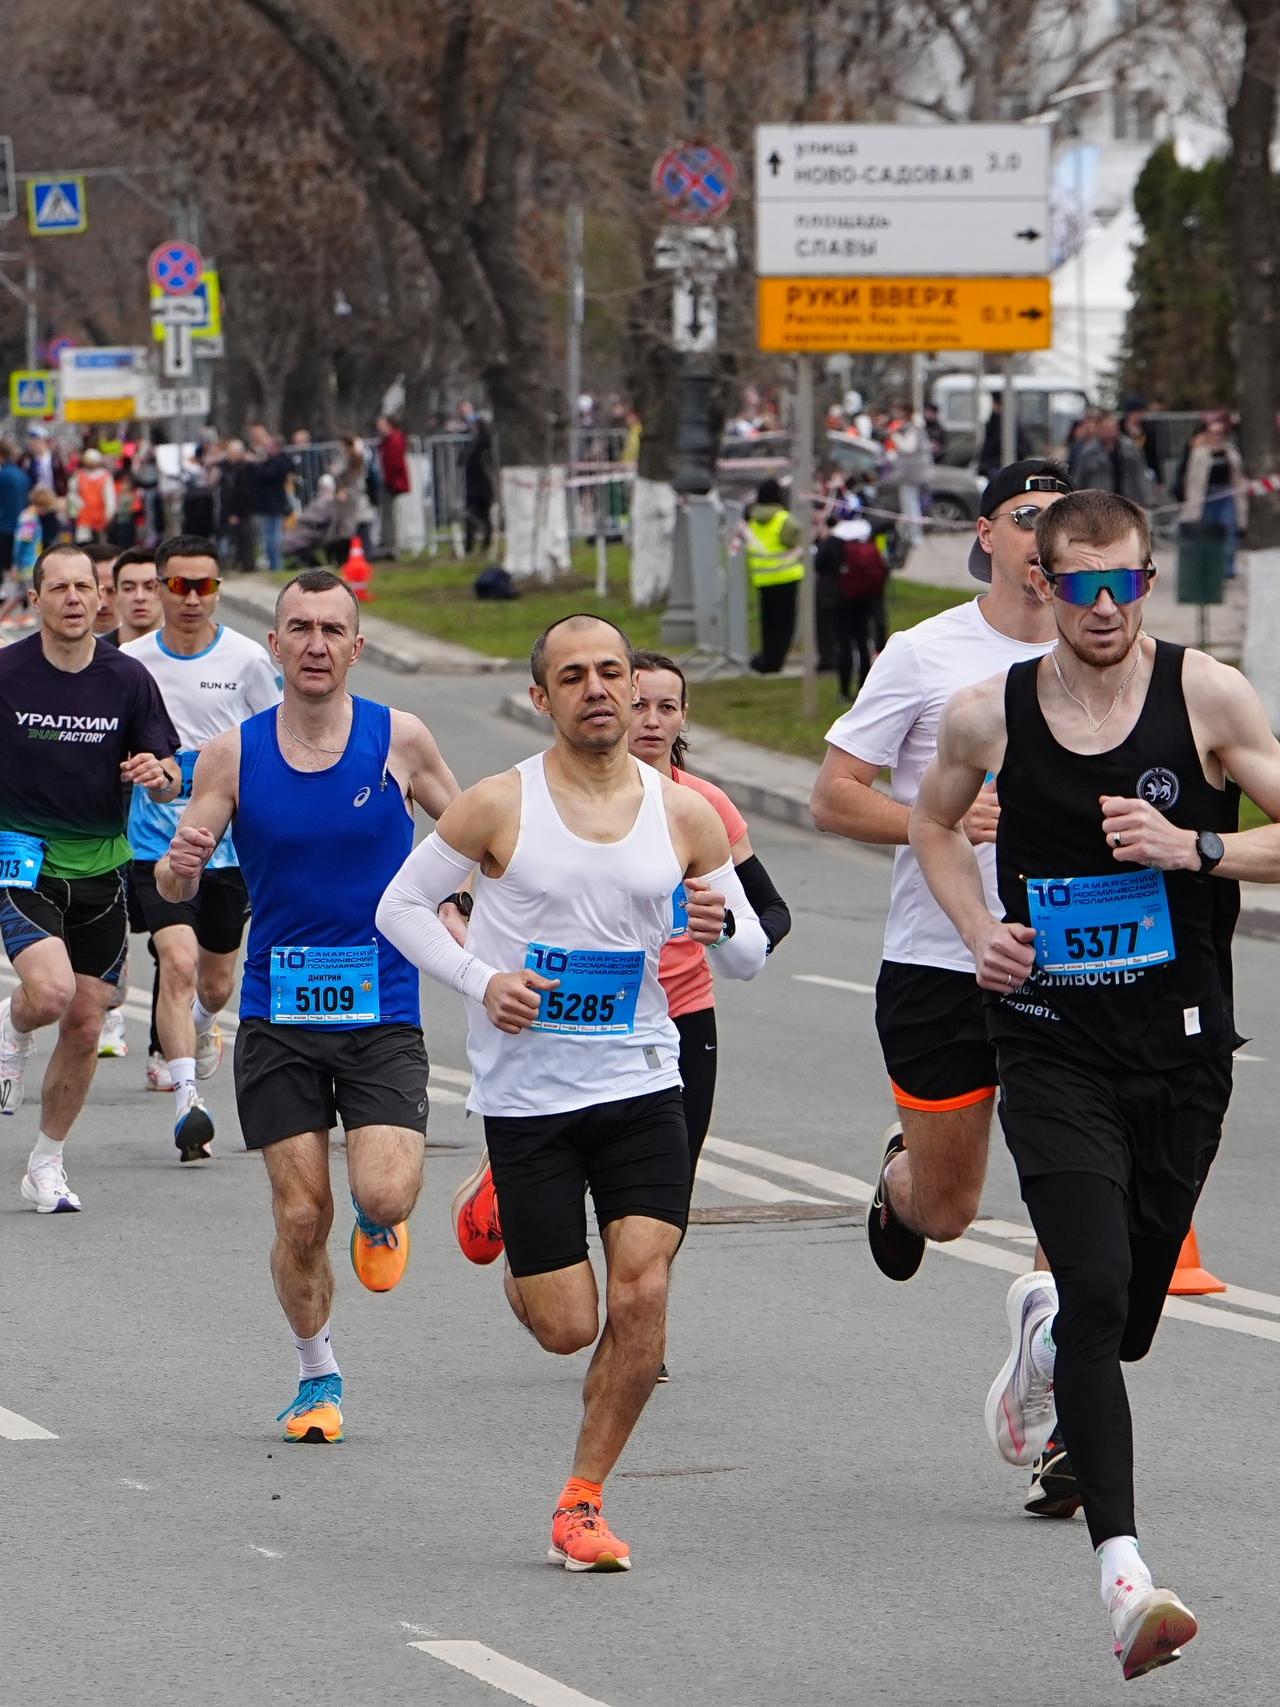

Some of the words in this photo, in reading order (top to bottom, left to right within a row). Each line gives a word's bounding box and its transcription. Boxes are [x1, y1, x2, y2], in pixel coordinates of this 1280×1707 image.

[794, 141, 857, 159] улица
[793, 165, 974, 186] НОВО-САДОВАЯ
[794, 214, 891, 231] площадь
[794, 237, 877, 259] СЛАВЫ
[786, 285, 860, 309] РУКИ
[869, 285, 959, 309] ВВЕРХ
[200, 681, 222, 689] RUN
[15, 711, 119, 731] УРАЛХИМ
[1072, 873, 1158, 891] САМАРСКИЙ
[1073, 881, 1159, 898] КОСМИЧЕСКИЙ
[1033, 884, 1071, 907] 10
[1074, 888, 1160, 906] ПОЛУМАРАФОН
[1146, 907, 1162, 915] 2025
[1064, 921, 1139, 960] 5377
[275, 951, 306, 969] 10
[307, 948, 375, 957] САМАРСКИЙ
[533, 949, 568, 973] 10
[570, 955, 641, 963] САМАРСКИЙ
[307, 962, 374, 970] ПОЛУМАРАФОН
[307, 973, 342, 982] ДМИТРИЙ
[295, 985, 354, 1013] 5109
[546, 991, 616, 1023] 5285
